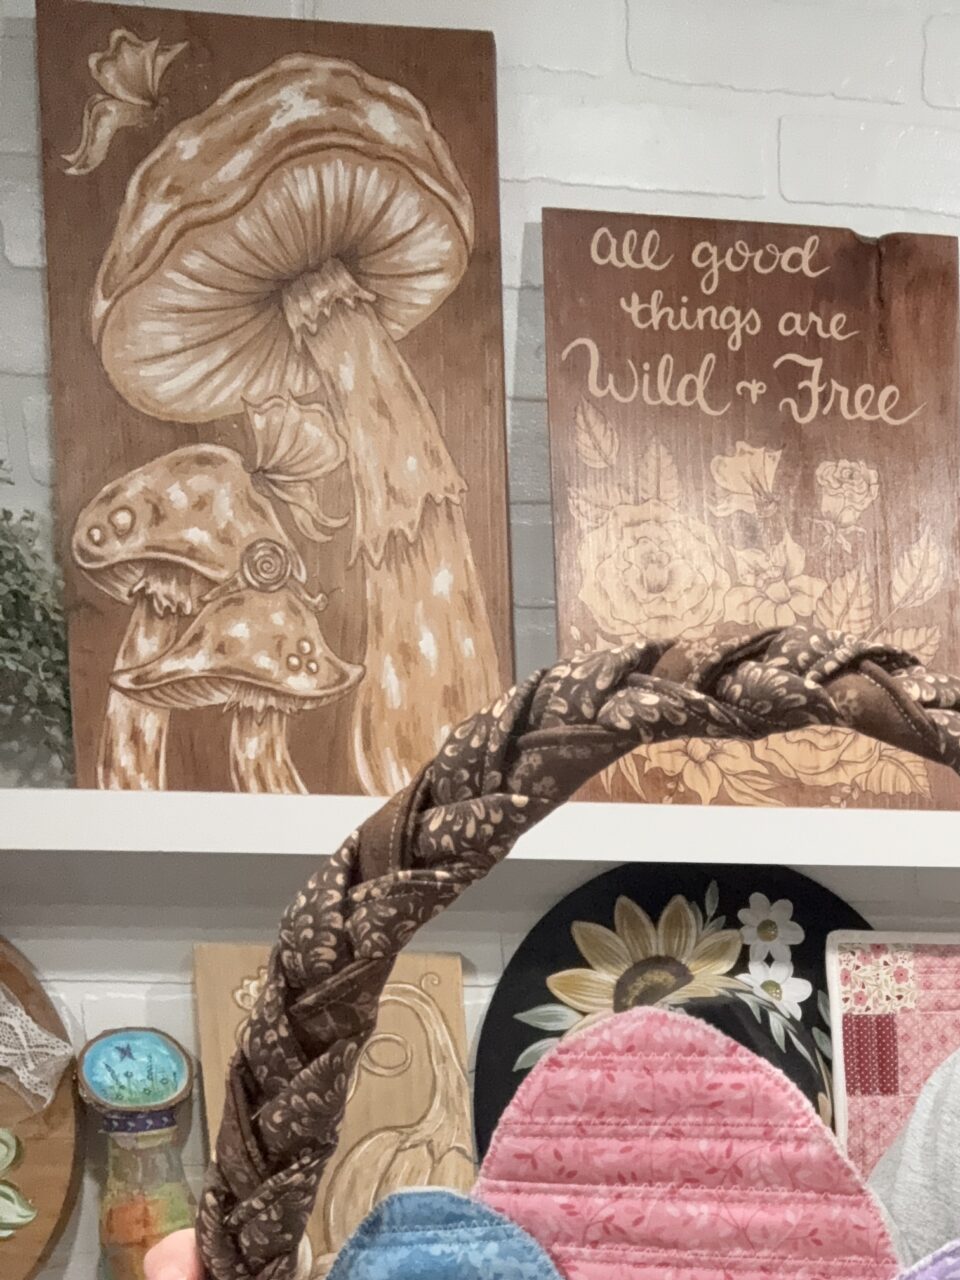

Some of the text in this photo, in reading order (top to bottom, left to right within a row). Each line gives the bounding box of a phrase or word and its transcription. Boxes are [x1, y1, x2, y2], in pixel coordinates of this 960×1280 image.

[691, 235, 832, 296] good
[620, 290, 860, 351] things are
[561, 338, 732, 416] Wild
[773, 353, 928, 425] Free
